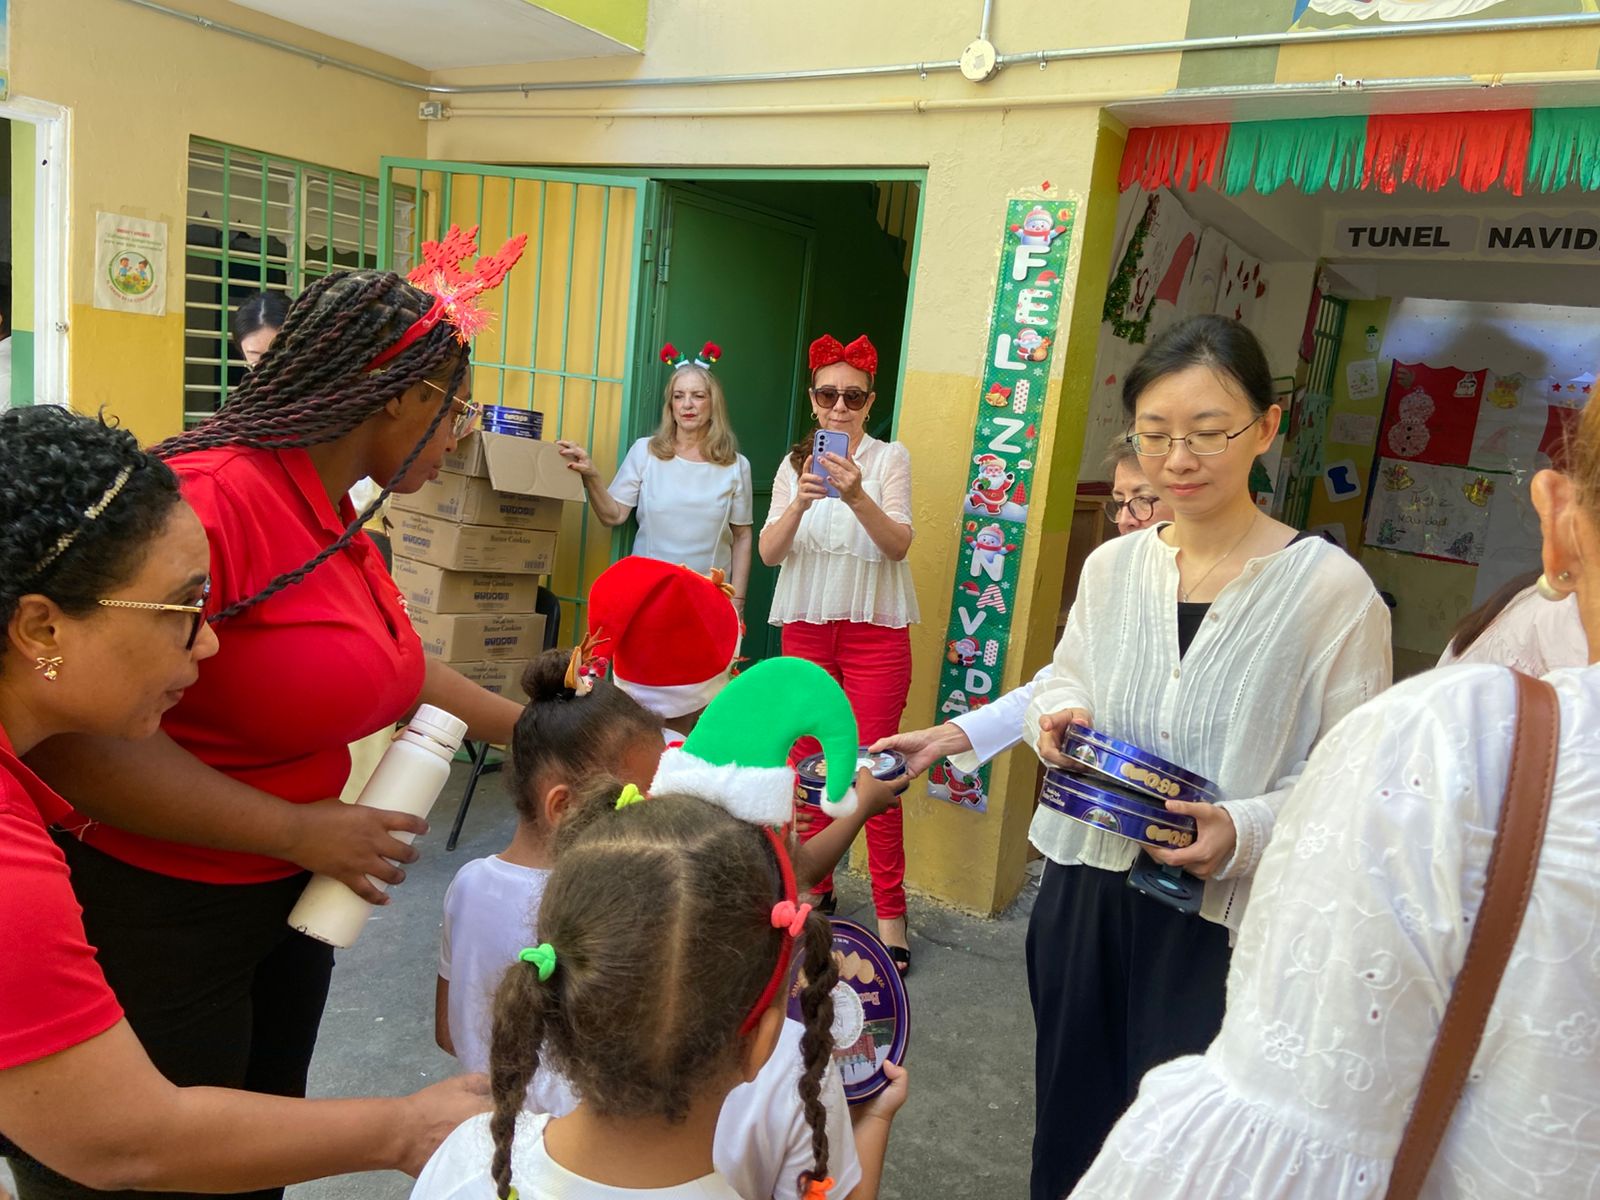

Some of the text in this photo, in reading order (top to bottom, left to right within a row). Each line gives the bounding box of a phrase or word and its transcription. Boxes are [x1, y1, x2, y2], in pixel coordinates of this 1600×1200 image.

[1348, 225, 1600, 250] TUNEL NAVID
[988, 244, 1054, 454] FELIZ
[941, 549, 1007, 715] NAVIDA
